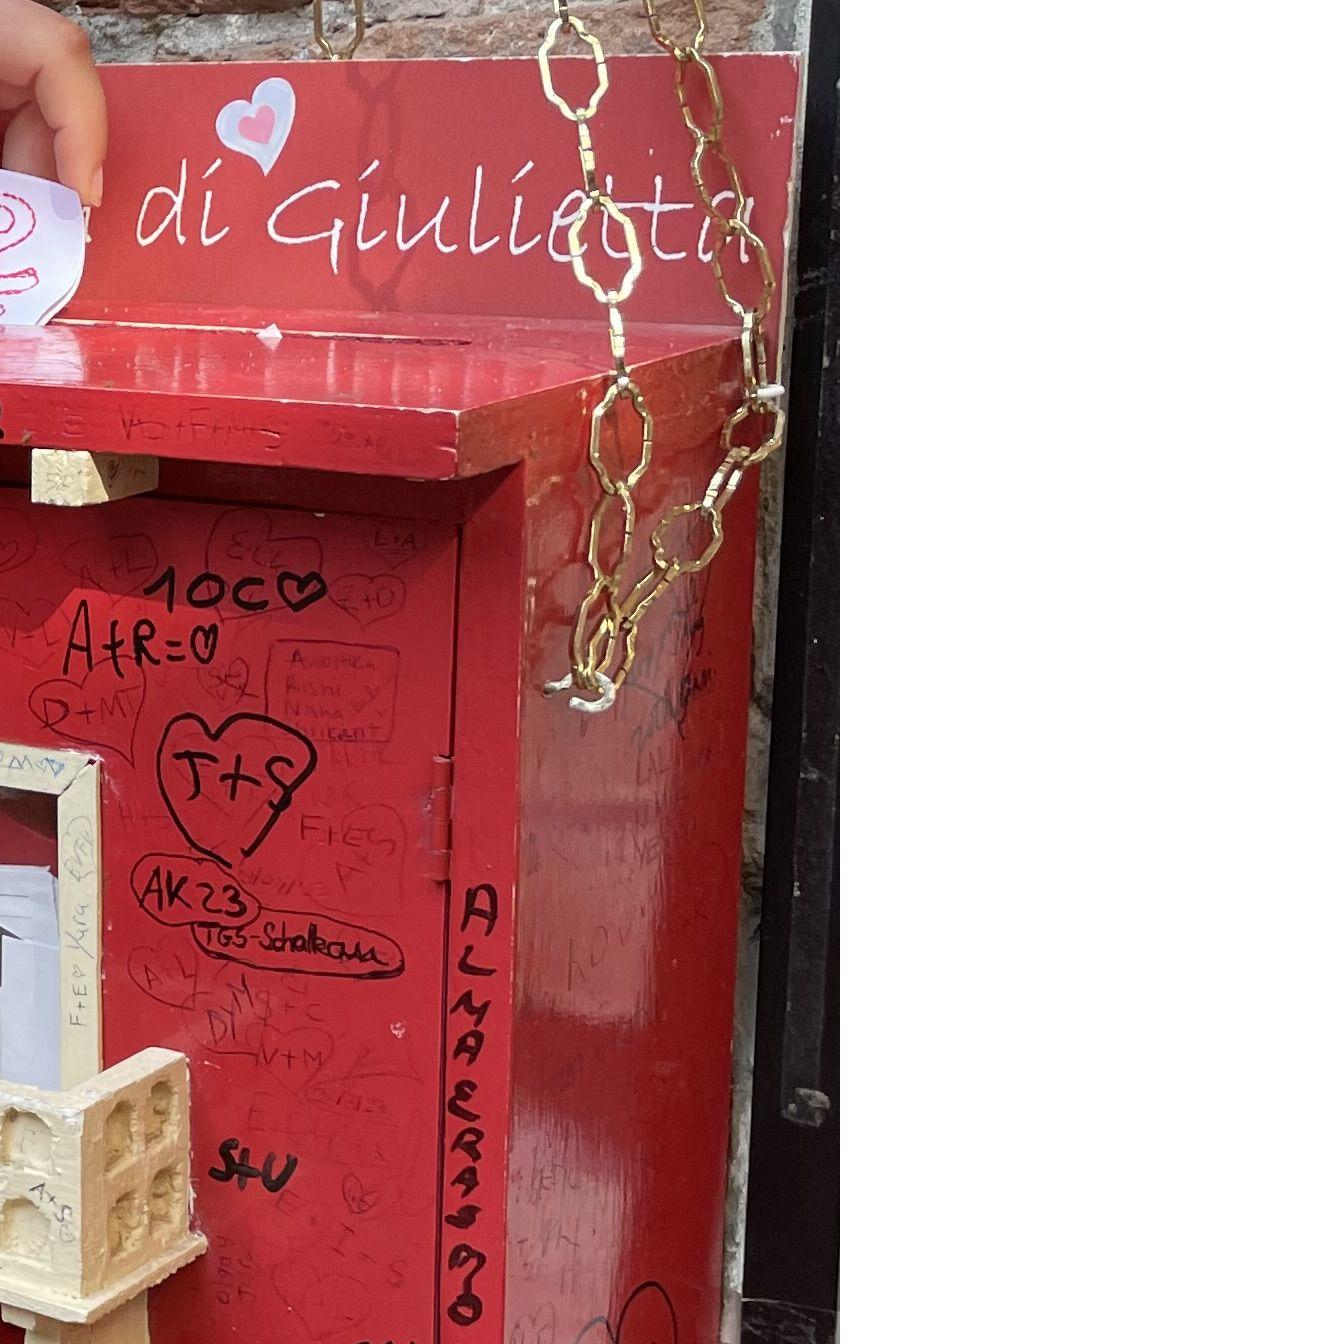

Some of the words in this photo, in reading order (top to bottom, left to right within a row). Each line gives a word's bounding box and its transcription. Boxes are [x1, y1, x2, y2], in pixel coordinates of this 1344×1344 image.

[135, 158, 229, 248] di
[266, 160, 755, 274] Giulietta
[140, 865, 193, 912] AK
[195, 882, 249, 919] 23
